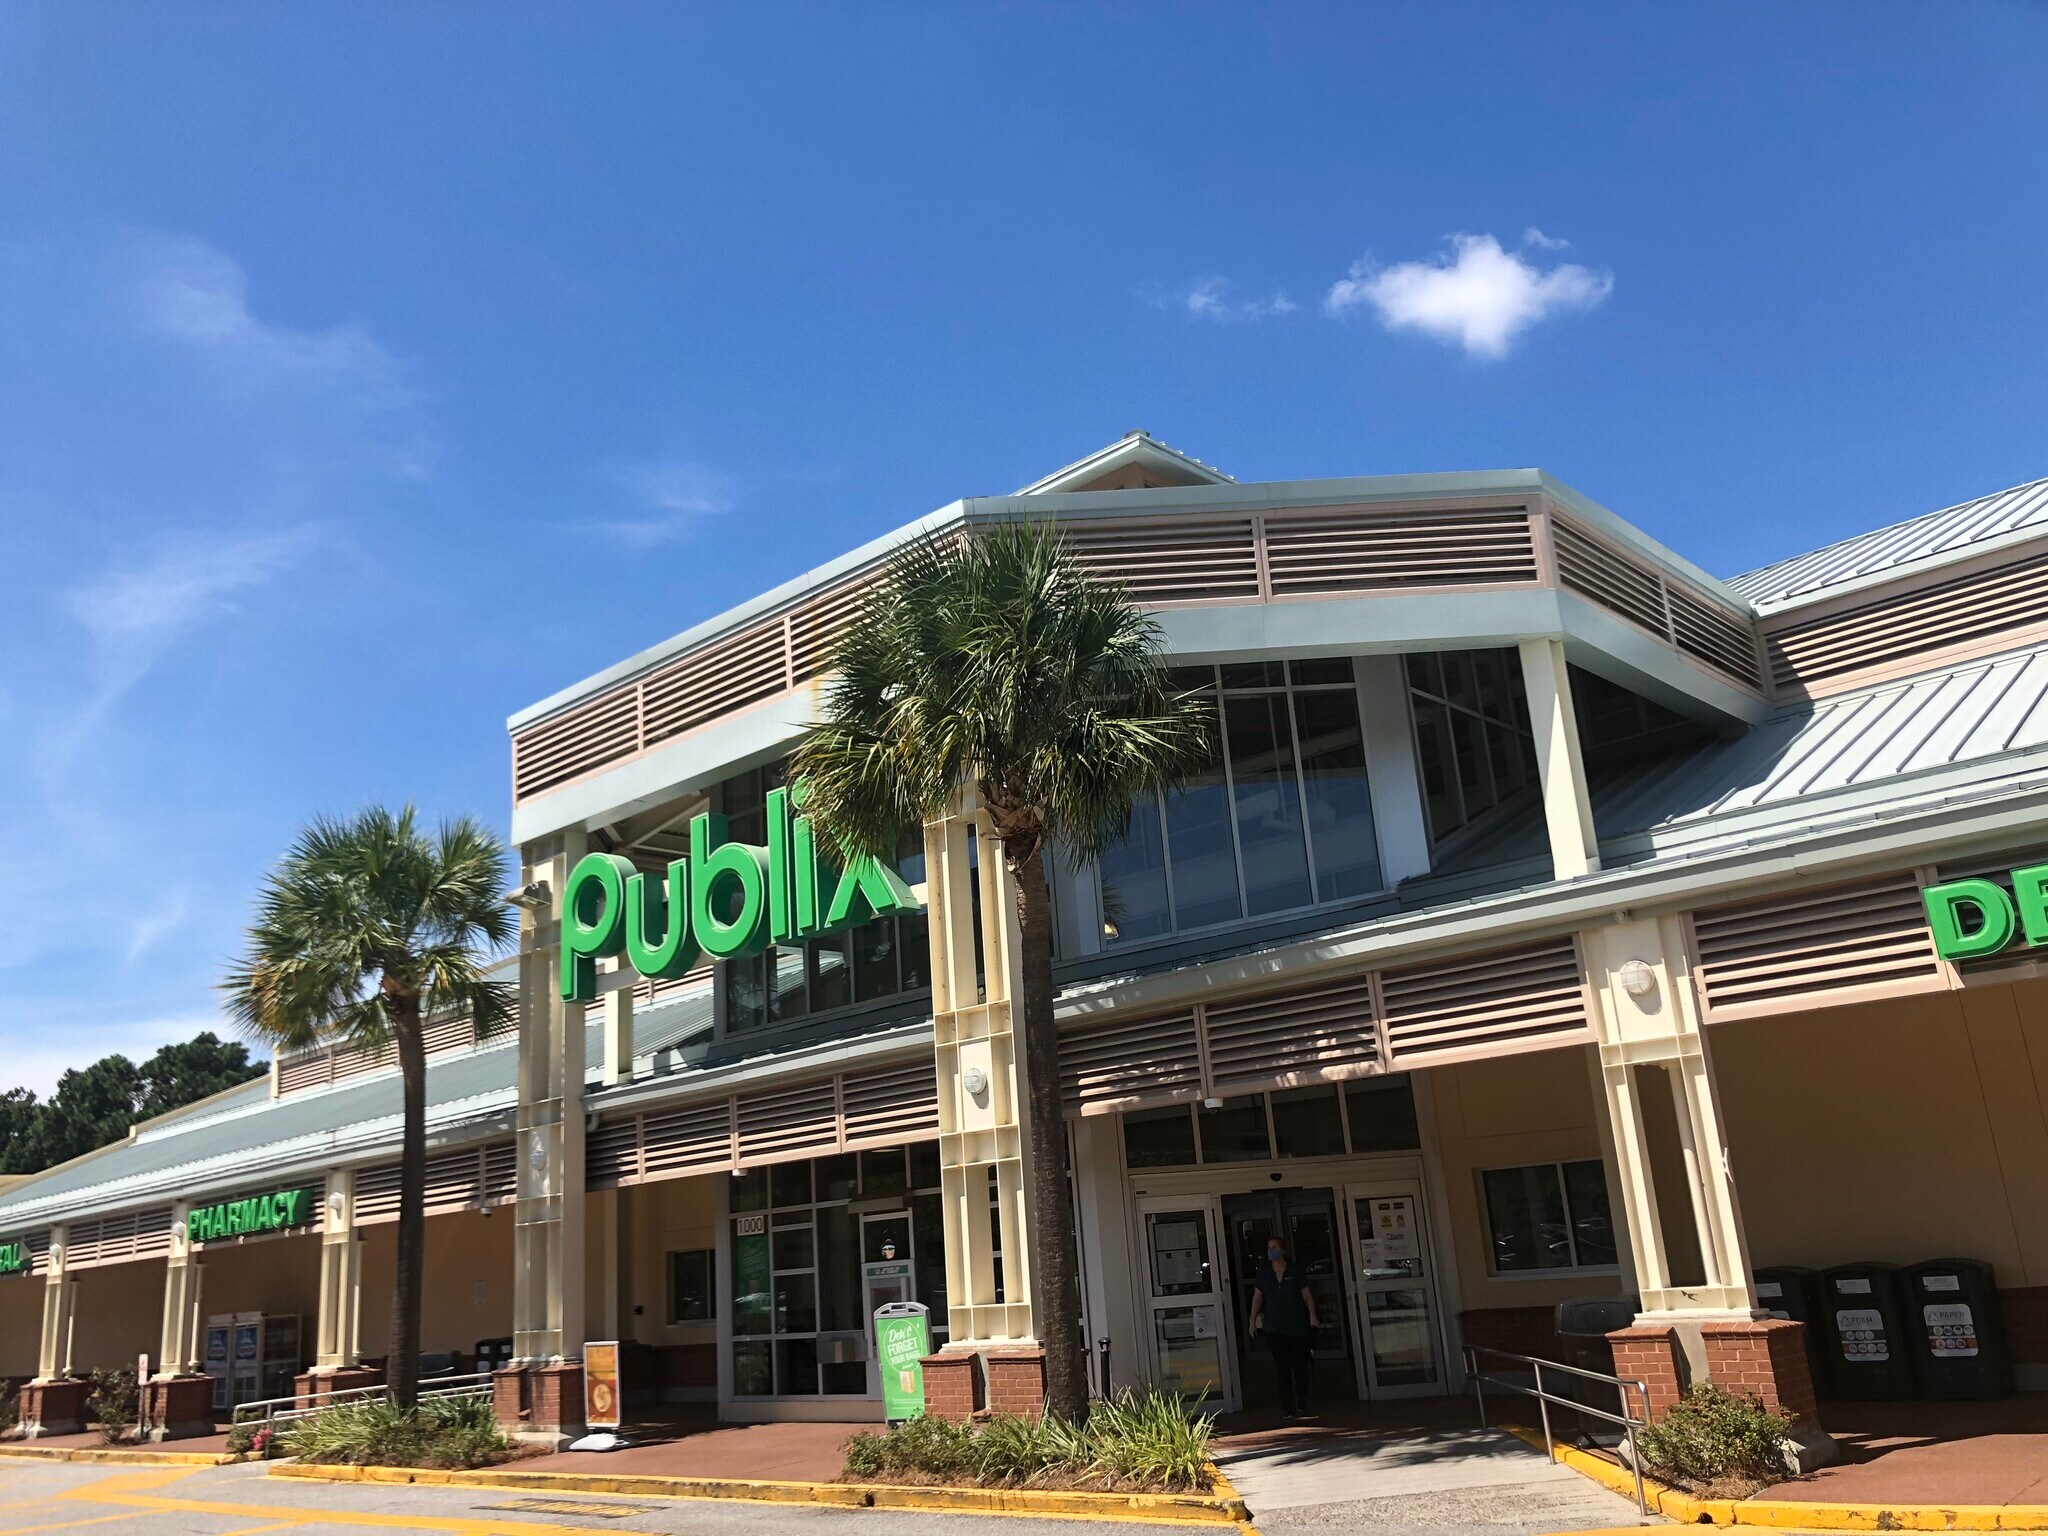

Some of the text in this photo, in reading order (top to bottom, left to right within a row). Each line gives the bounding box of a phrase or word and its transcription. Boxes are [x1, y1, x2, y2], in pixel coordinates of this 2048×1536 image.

[188, 1190, 301, 1241] PHARMACY
[738, 1217, 763, 1234] 1000
[1851, 1316, 1873, 1325] FOAM
[1939, 1311, 1965, 1320] PAPER
[887, 1336, 918, 1357] FORGET
